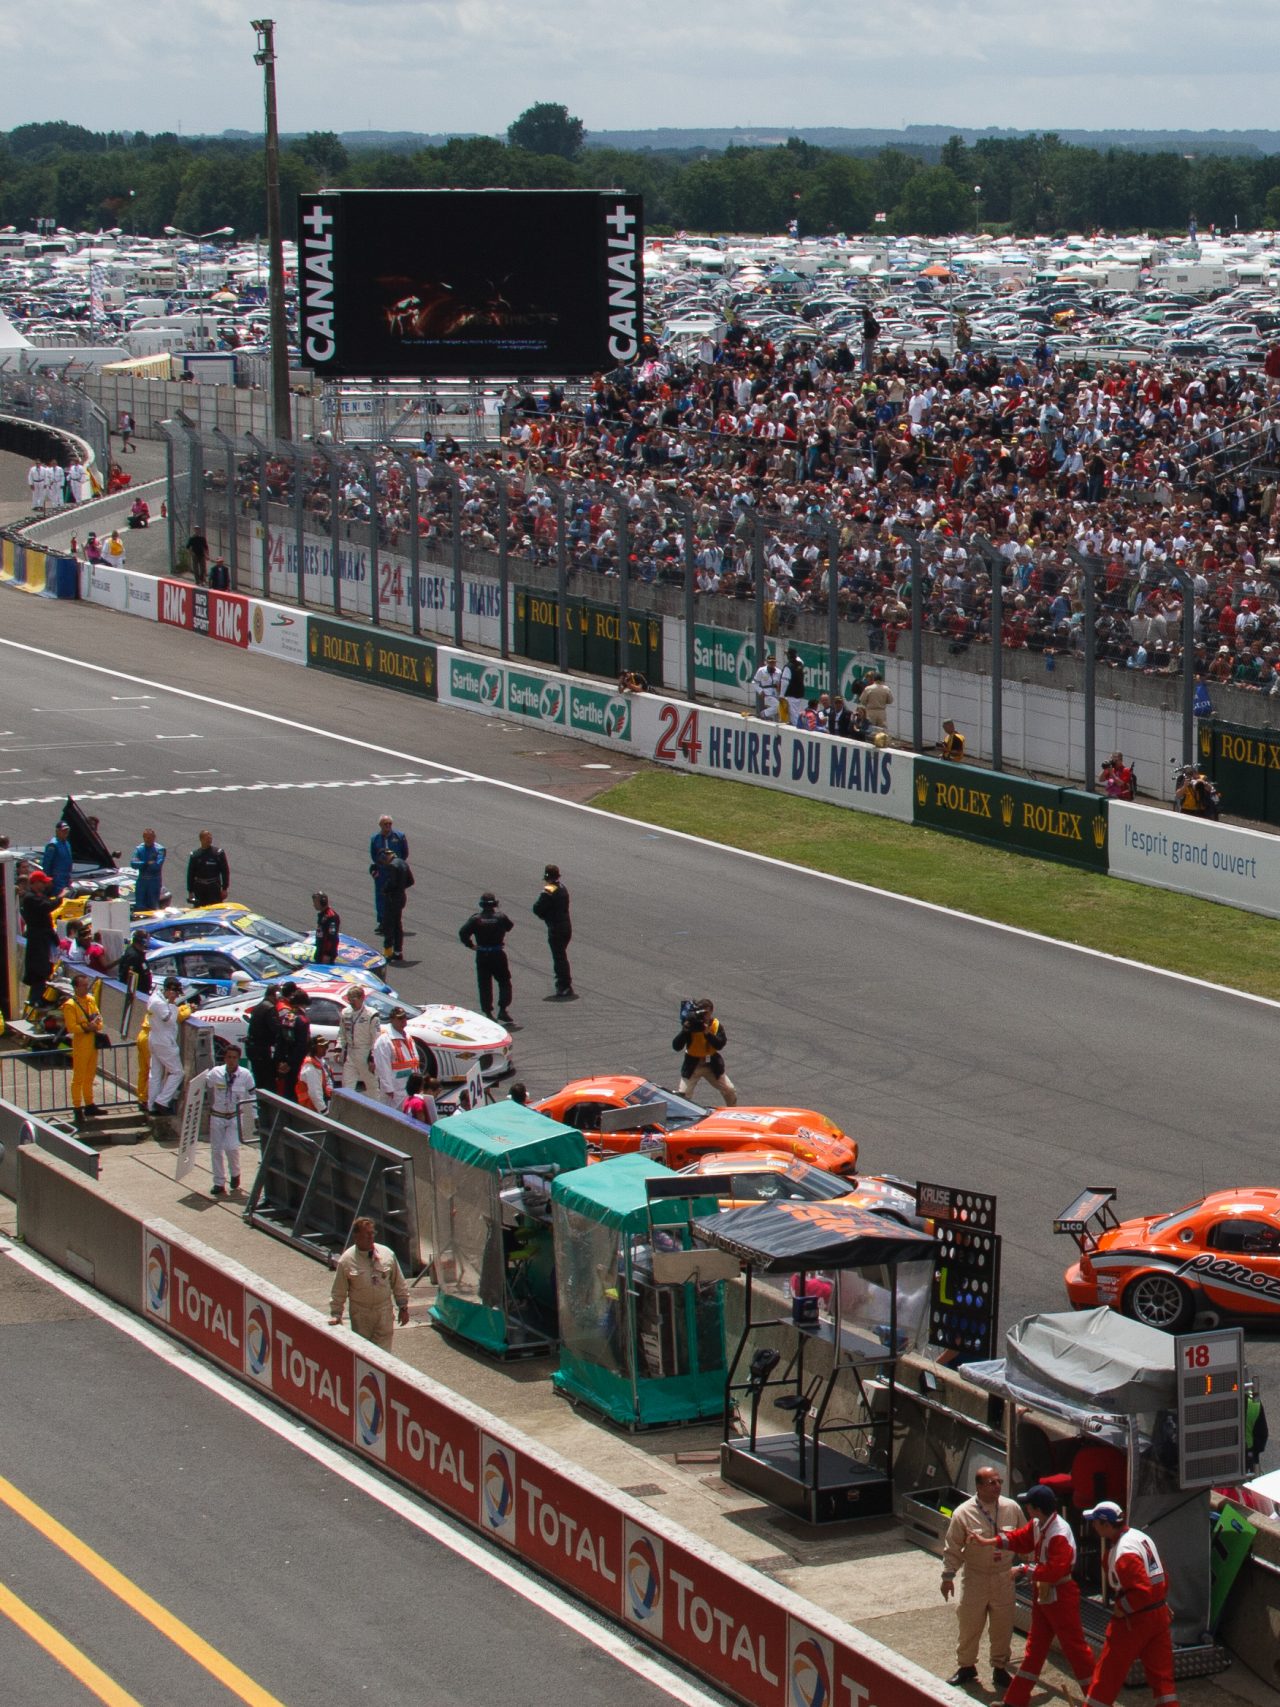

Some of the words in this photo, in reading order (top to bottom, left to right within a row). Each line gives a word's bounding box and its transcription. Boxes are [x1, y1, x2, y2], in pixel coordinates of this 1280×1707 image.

[303, 205, 336, 362] CANAL+
[606, 204, 639, 360] CANAL+
[163, 583, 187, 626] RMC
[379, 561, 404, 606] 24
[469, 582, 501, 618] MANS
[193, 616, 210, 632] SPORT
[215, 598, 242, 643] RMC
[323, 635, 361, 666] ROLEX
[379, 649, 419, 682] ROLEX
[693, 638, 735, 675] Sarthe
[452, 668, 479, 694] Sarthe
[510, 682, 540, 709] Sarthe
[572, 701, 604, 726] Sarthe
[655, 703, 703, 764] 24
[709, 725, 782, 778] HEURES
[791, 738, 821, 785] DU
[829, 744, 892, 795] MANS
[936, 782, 992, 819] ROLEX
[1023, 803, 1083, 841] ROLEX
[1124, 823, 1168, 857] l'esprit
[1172, 840, 1209, 866] grand
[1212, 851, 1257, 880] ouvert
[469, 1074, 483, 1108] 24
[920, 1186, 951, 1206] KRUSE
[1061, 1222, 1083, 1231] LICO
[173, 1266, 240, 1349] TOTAL
[275, 1329, 351, 1417] TOTAL
[1185, 1344, 1210, 1368] 18
[390, 1398, 475, 1494] TOTAL
[520, 1478, 616, 1585] TOTAL
[669, 1568, 779, 1688] TOTAL
